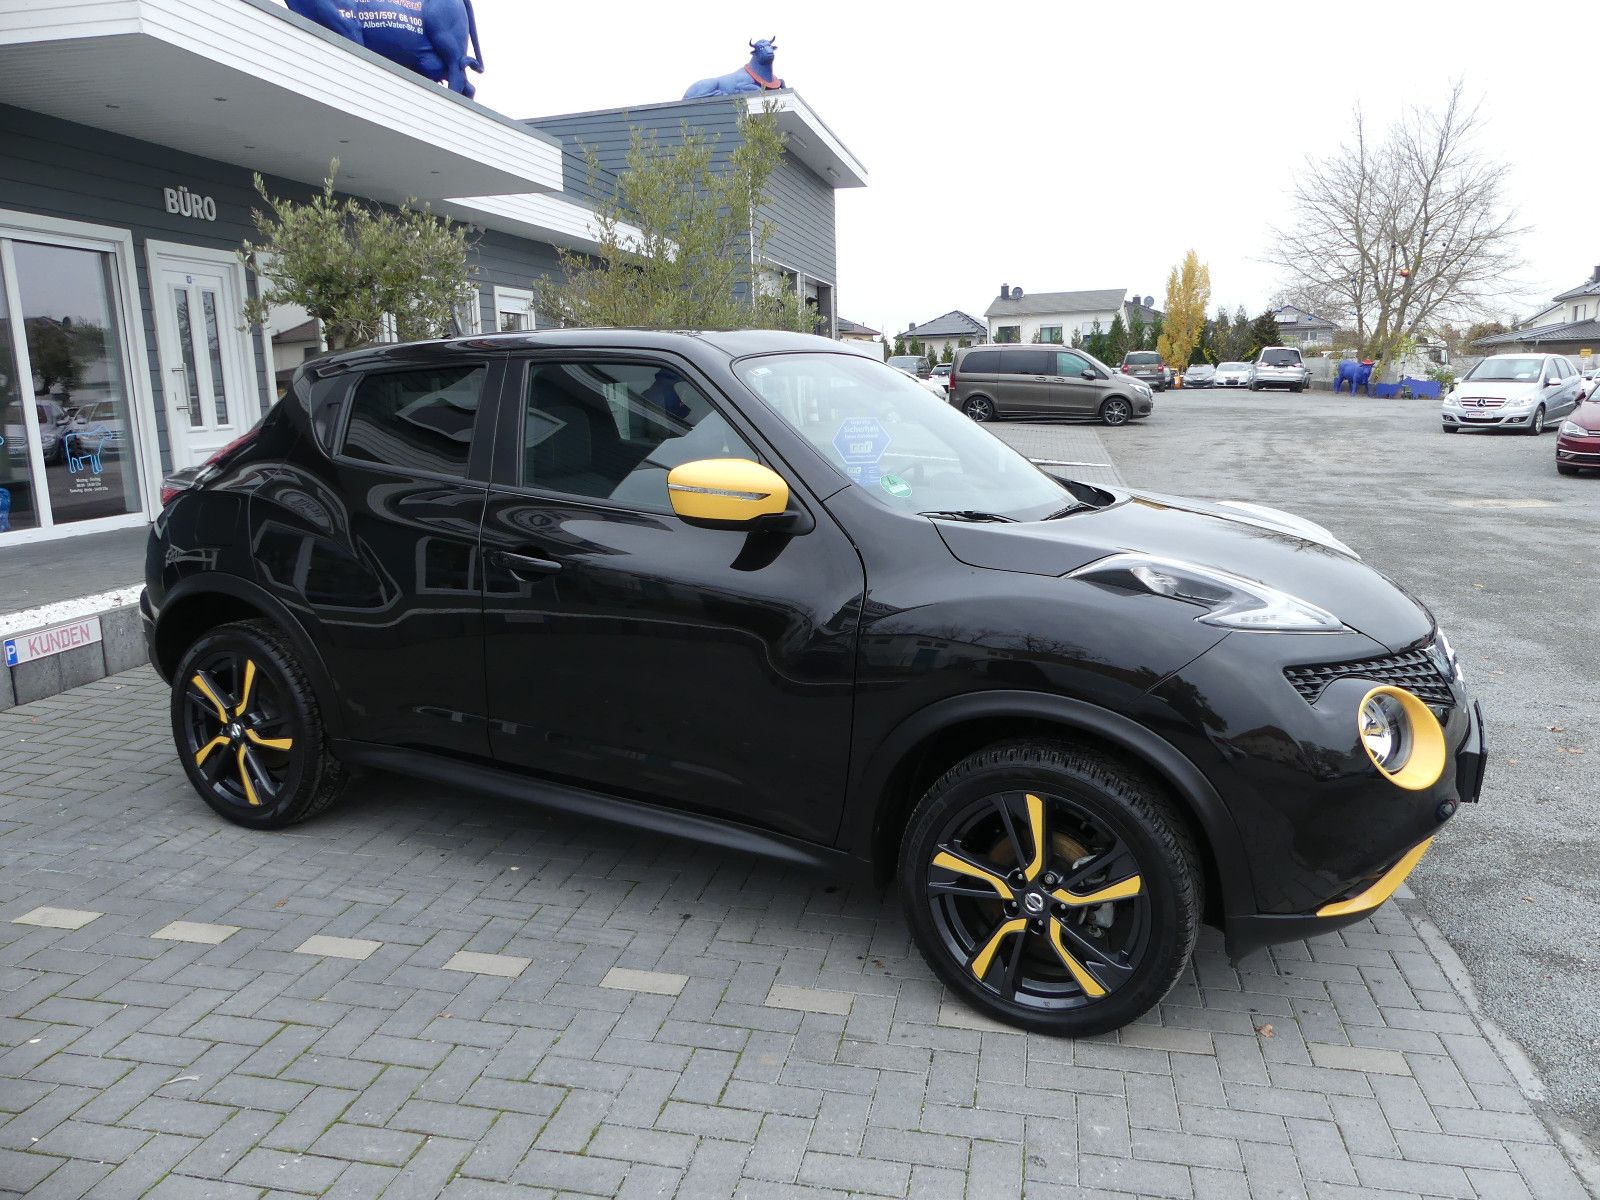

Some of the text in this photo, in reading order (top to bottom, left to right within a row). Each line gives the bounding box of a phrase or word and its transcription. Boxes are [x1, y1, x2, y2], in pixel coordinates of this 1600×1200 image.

[338, 9, 357, 18] Tel.
[358, 11, 397, 20] 0391/597
[409, 16, 422, 26] 100
[163, 185, 217, 221] BÜRO
[6, 623, 91, 661] P KUNDEN
